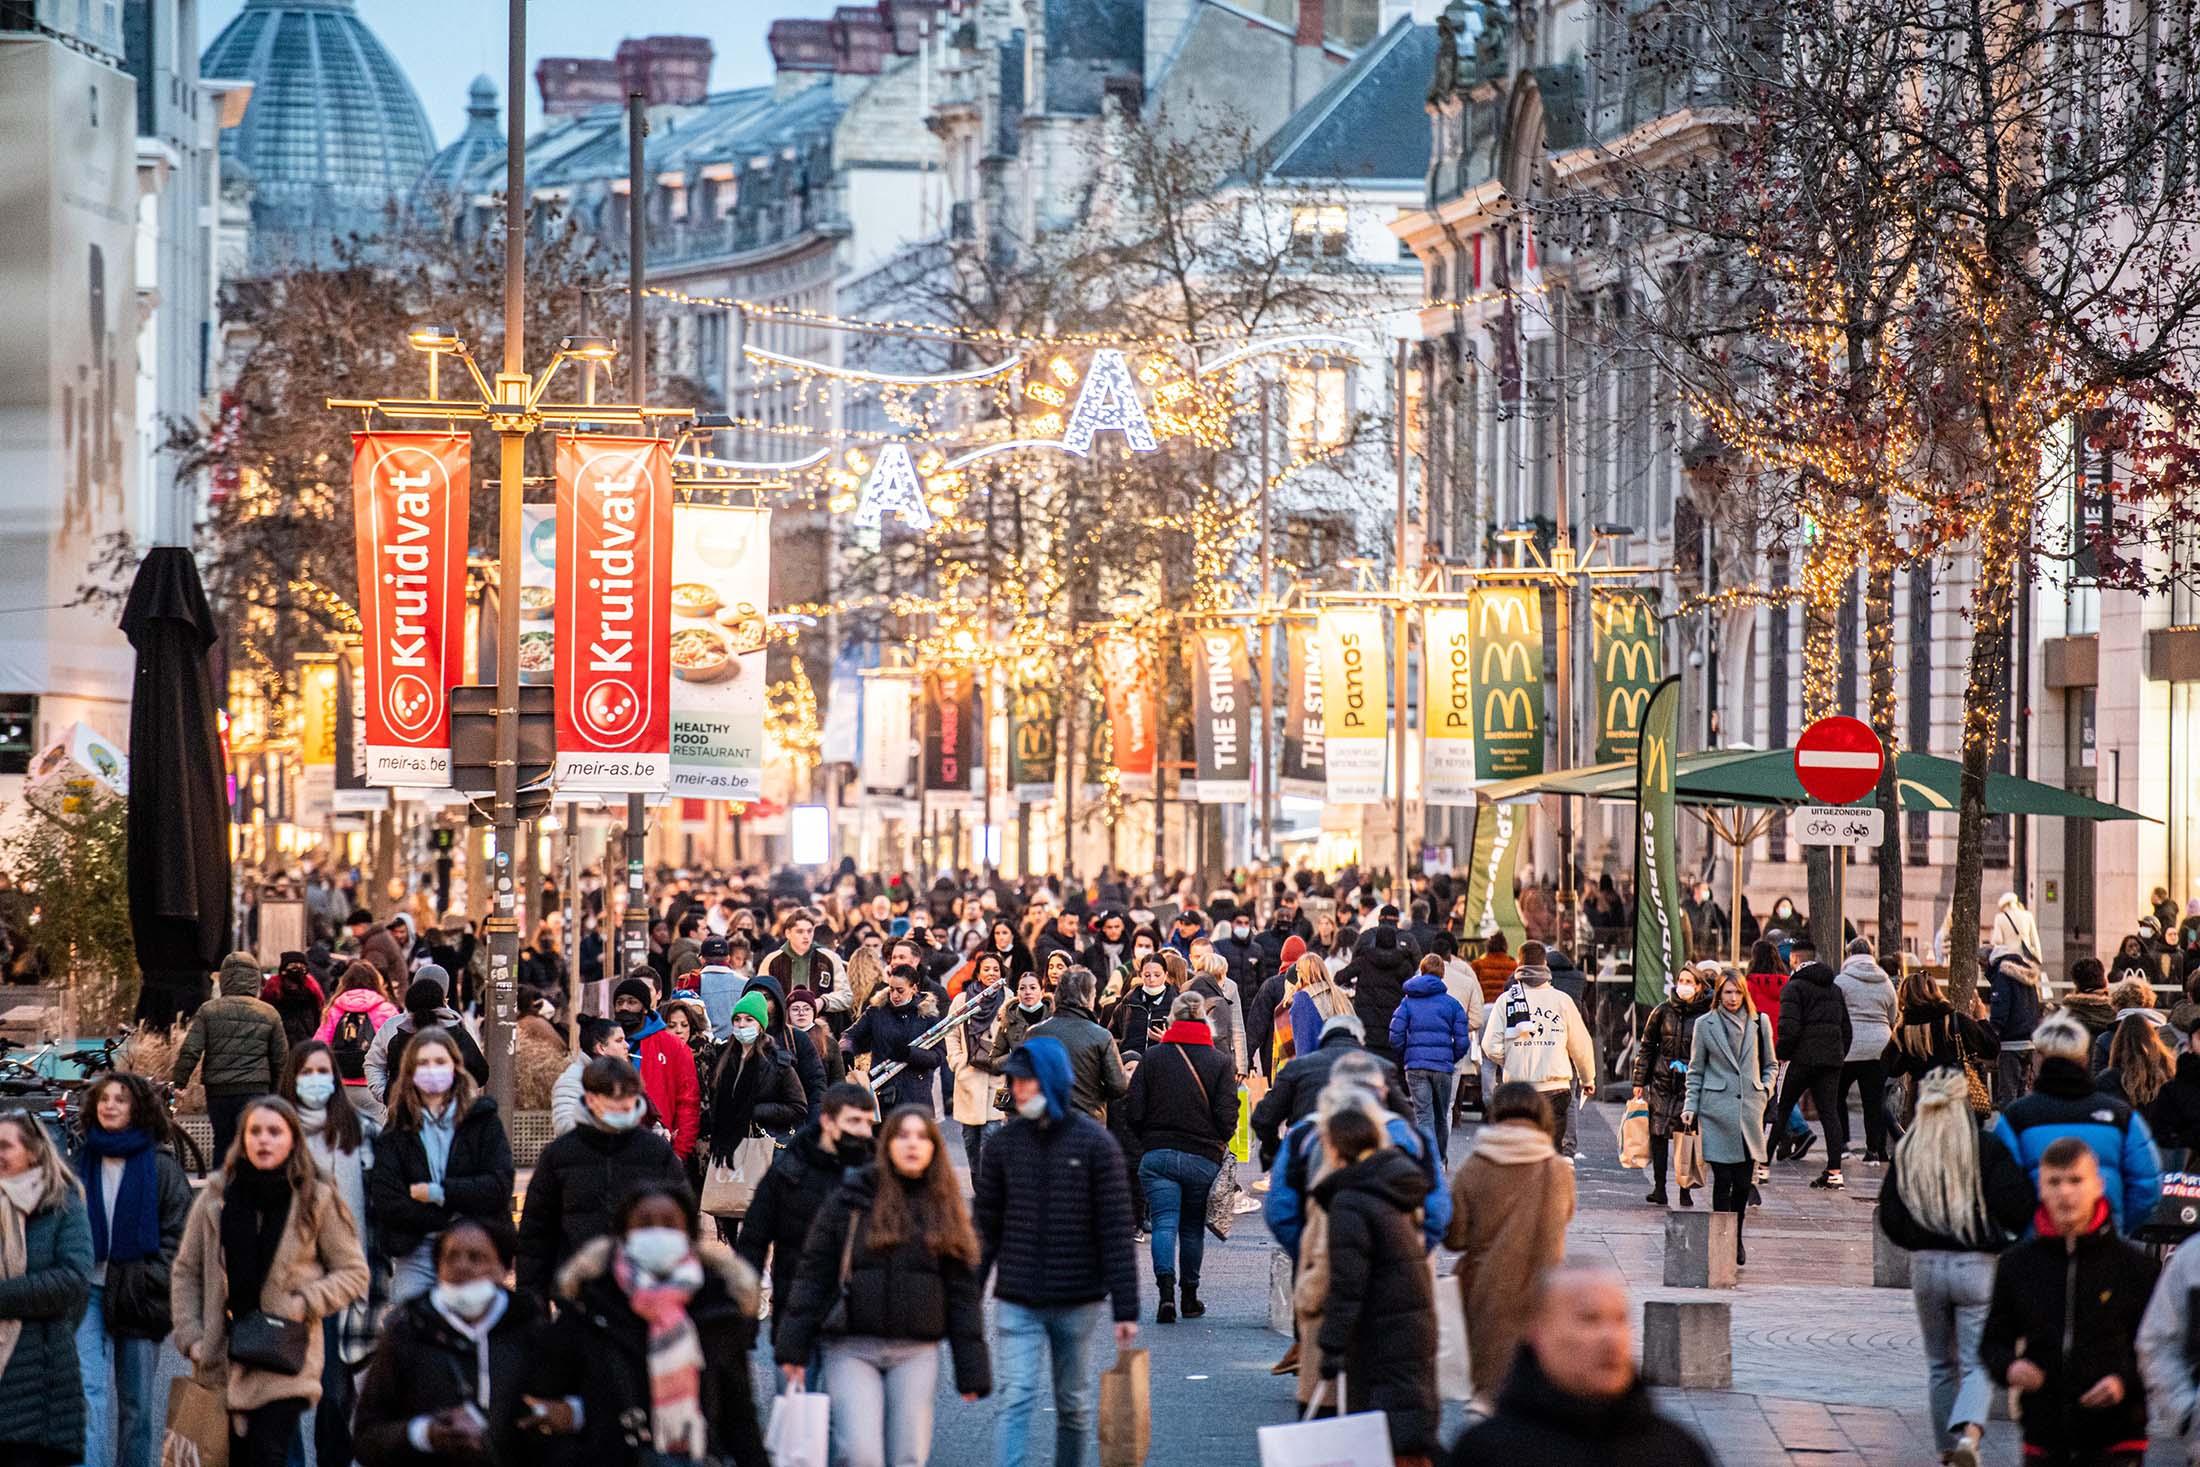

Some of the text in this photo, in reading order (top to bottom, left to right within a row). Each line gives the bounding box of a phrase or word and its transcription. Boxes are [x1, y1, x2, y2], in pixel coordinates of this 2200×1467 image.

[384, 470, 431, 668] Kruidvat
[589, 474, 636, 673] Kruidvat
[1206, 637, 1236, 713] STING
[1342, 633, 1365, 727] Panos
[1447, 633, 1468, 727] Panos
[674, 722, 730, 734] HEALTHY
[674, 734, 709, 745] FOOD
[1211, 717, 1237, 770] THE
[1301, 717, 1325, 769] THE
[378, 755, 447, 771] meir-as.be
[567, 761, 655, 776] meir-as.be
[673, 745, 752, 758] RESTAURANT
[675, 772, 749, 787] meir-as.be
[1811, 808, 1872, 817] UITGEZONDERD
[1643, 811, 1674, 996] McDonald's
[1529, 1006, 1561, 1024] ACE
